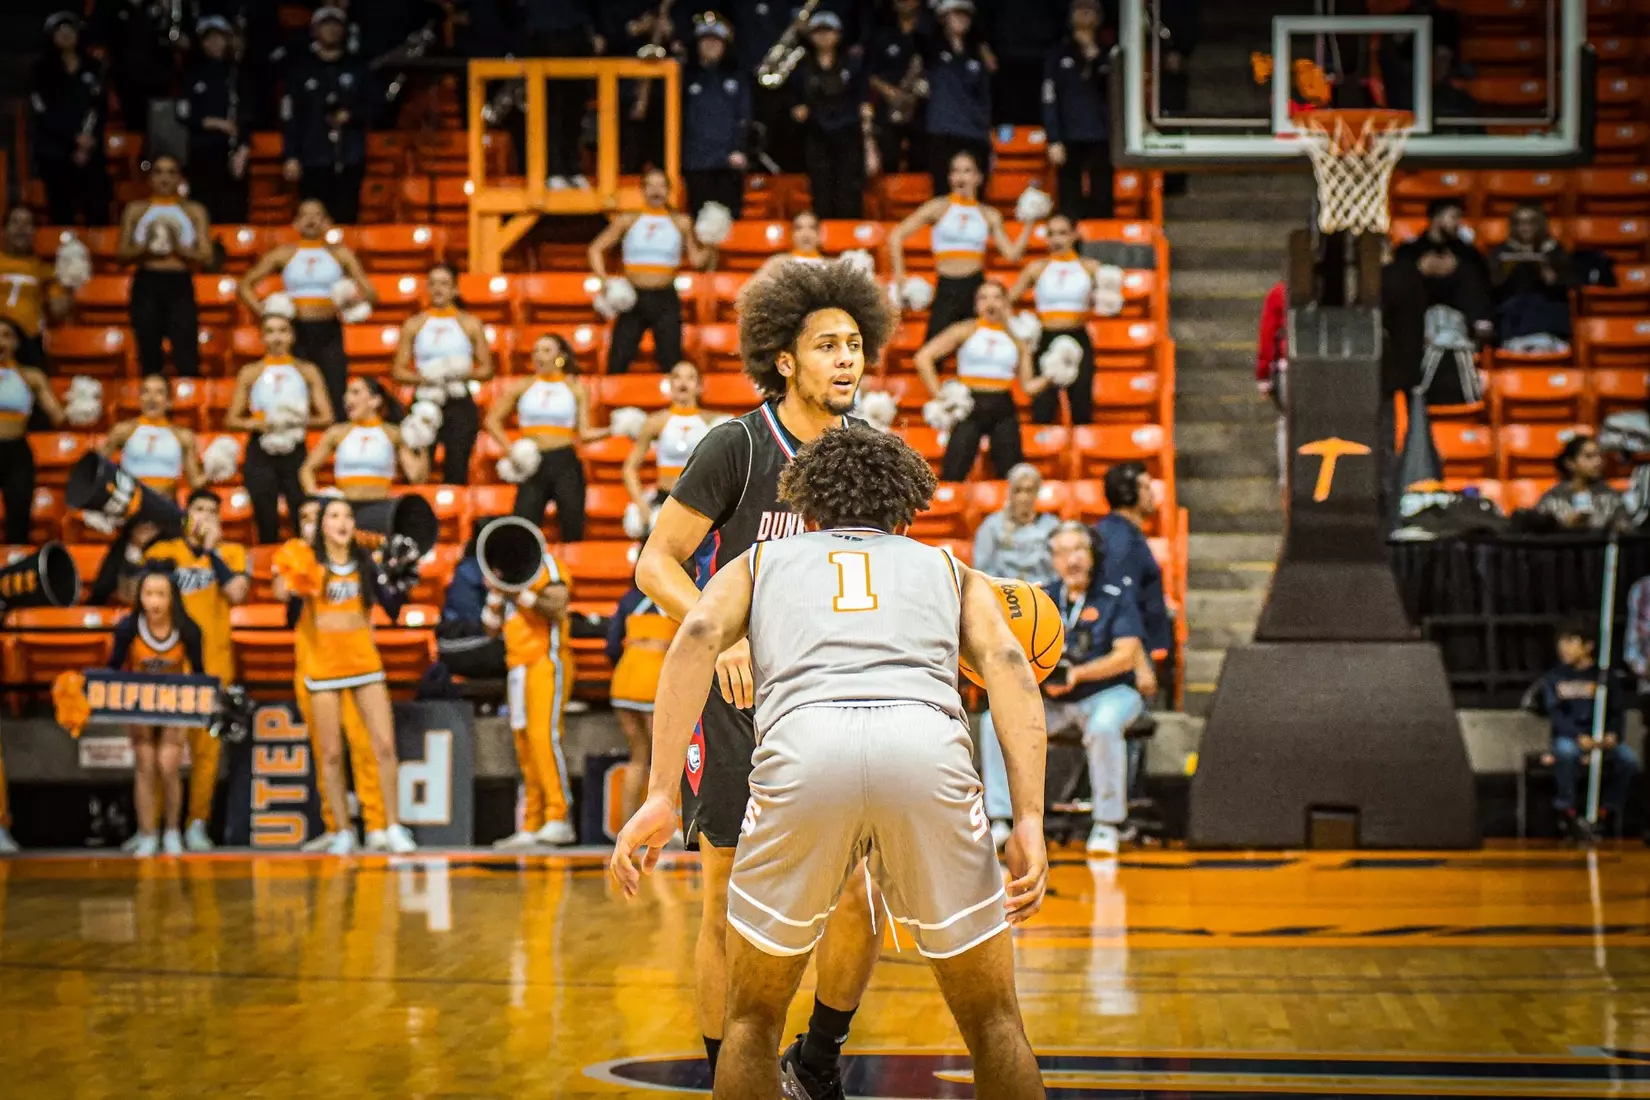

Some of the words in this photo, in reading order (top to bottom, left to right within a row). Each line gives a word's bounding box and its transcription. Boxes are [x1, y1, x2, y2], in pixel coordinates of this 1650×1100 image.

[828, 550, 878, 612] 1
[87, 680, 218, 714] DEFENSE
[251, 706, 310, 847] UTEP
